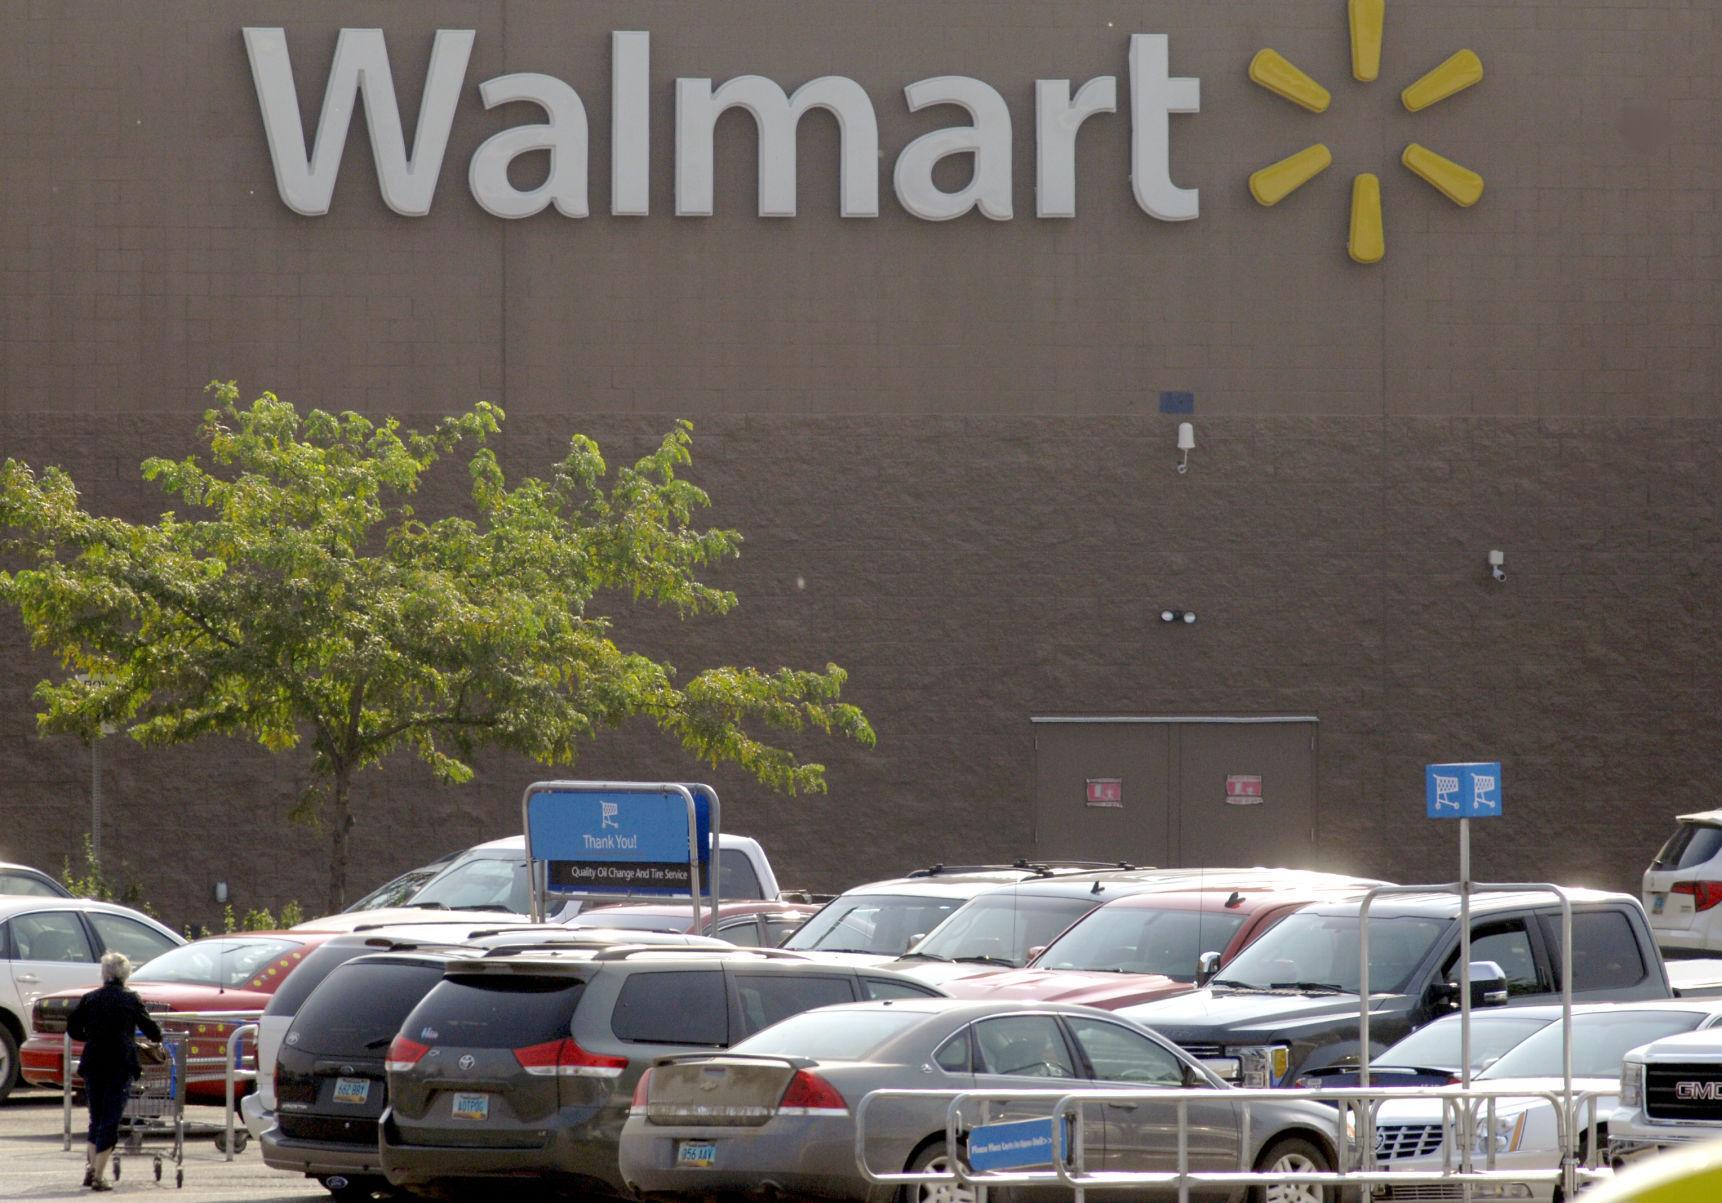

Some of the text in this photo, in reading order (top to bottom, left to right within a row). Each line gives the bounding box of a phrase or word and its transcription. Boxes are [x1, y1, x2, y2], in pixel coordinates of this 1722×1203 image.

[242, 26, 1200, 222] Walmart
[582, 834, 637, 849] Thank You!
[571, 866, 688, 881] Quality Oil Change And Tire Service
[1676, 1081, 1722, 1100] GMC
